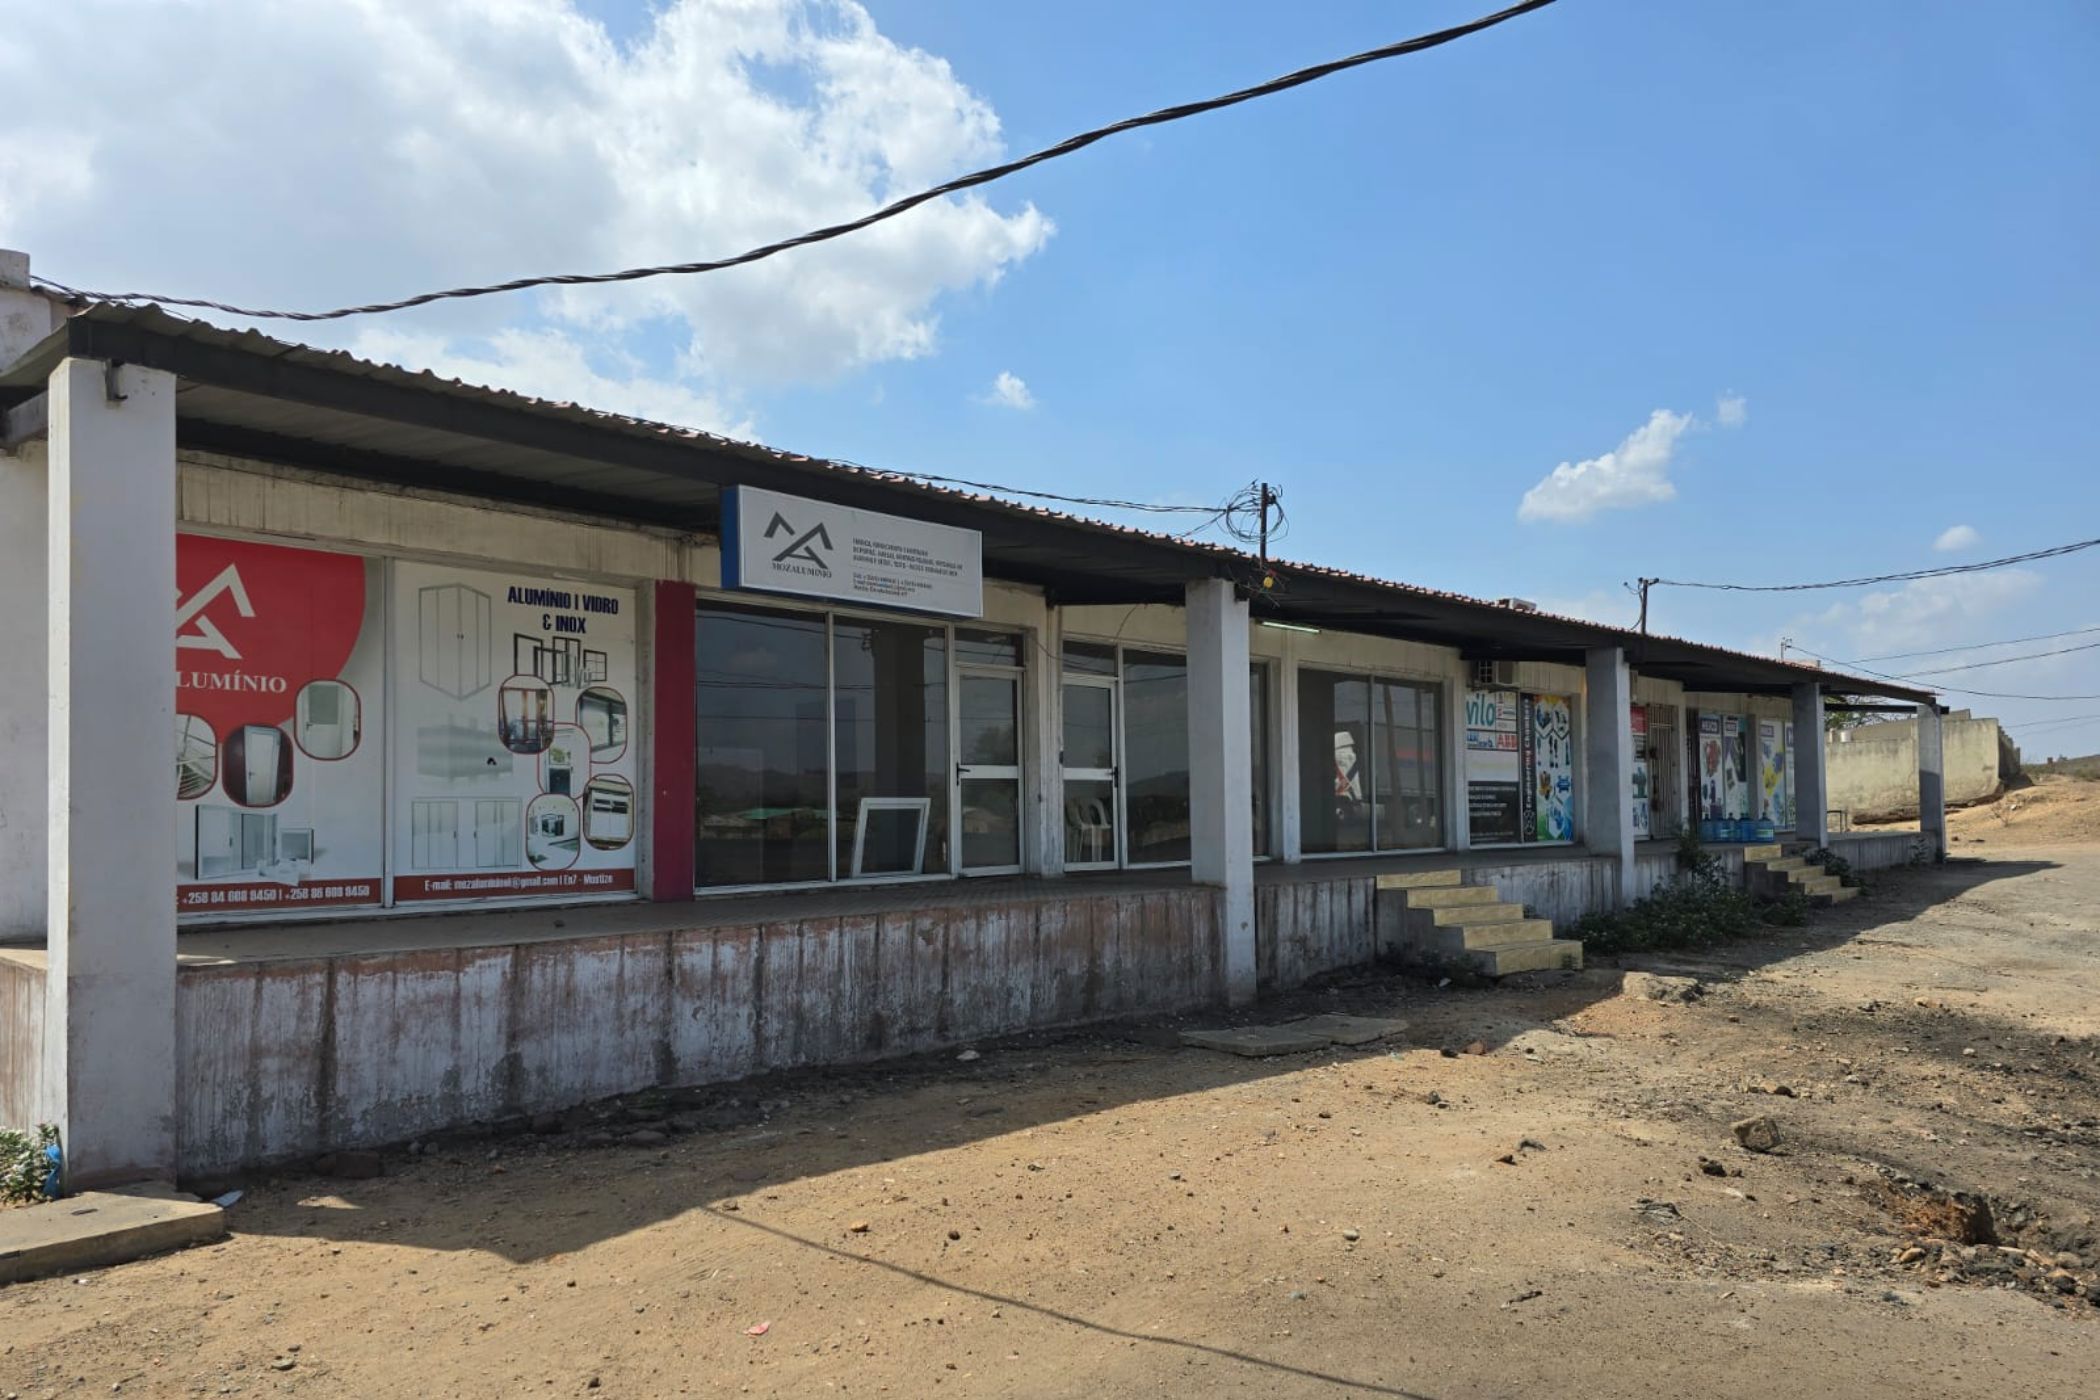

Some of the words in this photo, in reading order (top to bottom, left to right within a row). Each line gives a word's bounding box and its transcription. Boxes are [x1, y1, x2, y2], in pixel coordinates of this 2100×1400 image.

[508, 586, 571, 610] ALUMÍNIO
[583, 595, 619, 615] VIDRO
[543, 614, 552, 630] &
[556, 615, 586, 634] INOX
[176, 669, 287, 693] LUMÍNIO
[183, 891, 208, 905] +258
[285, 887, 308, 900] +258
